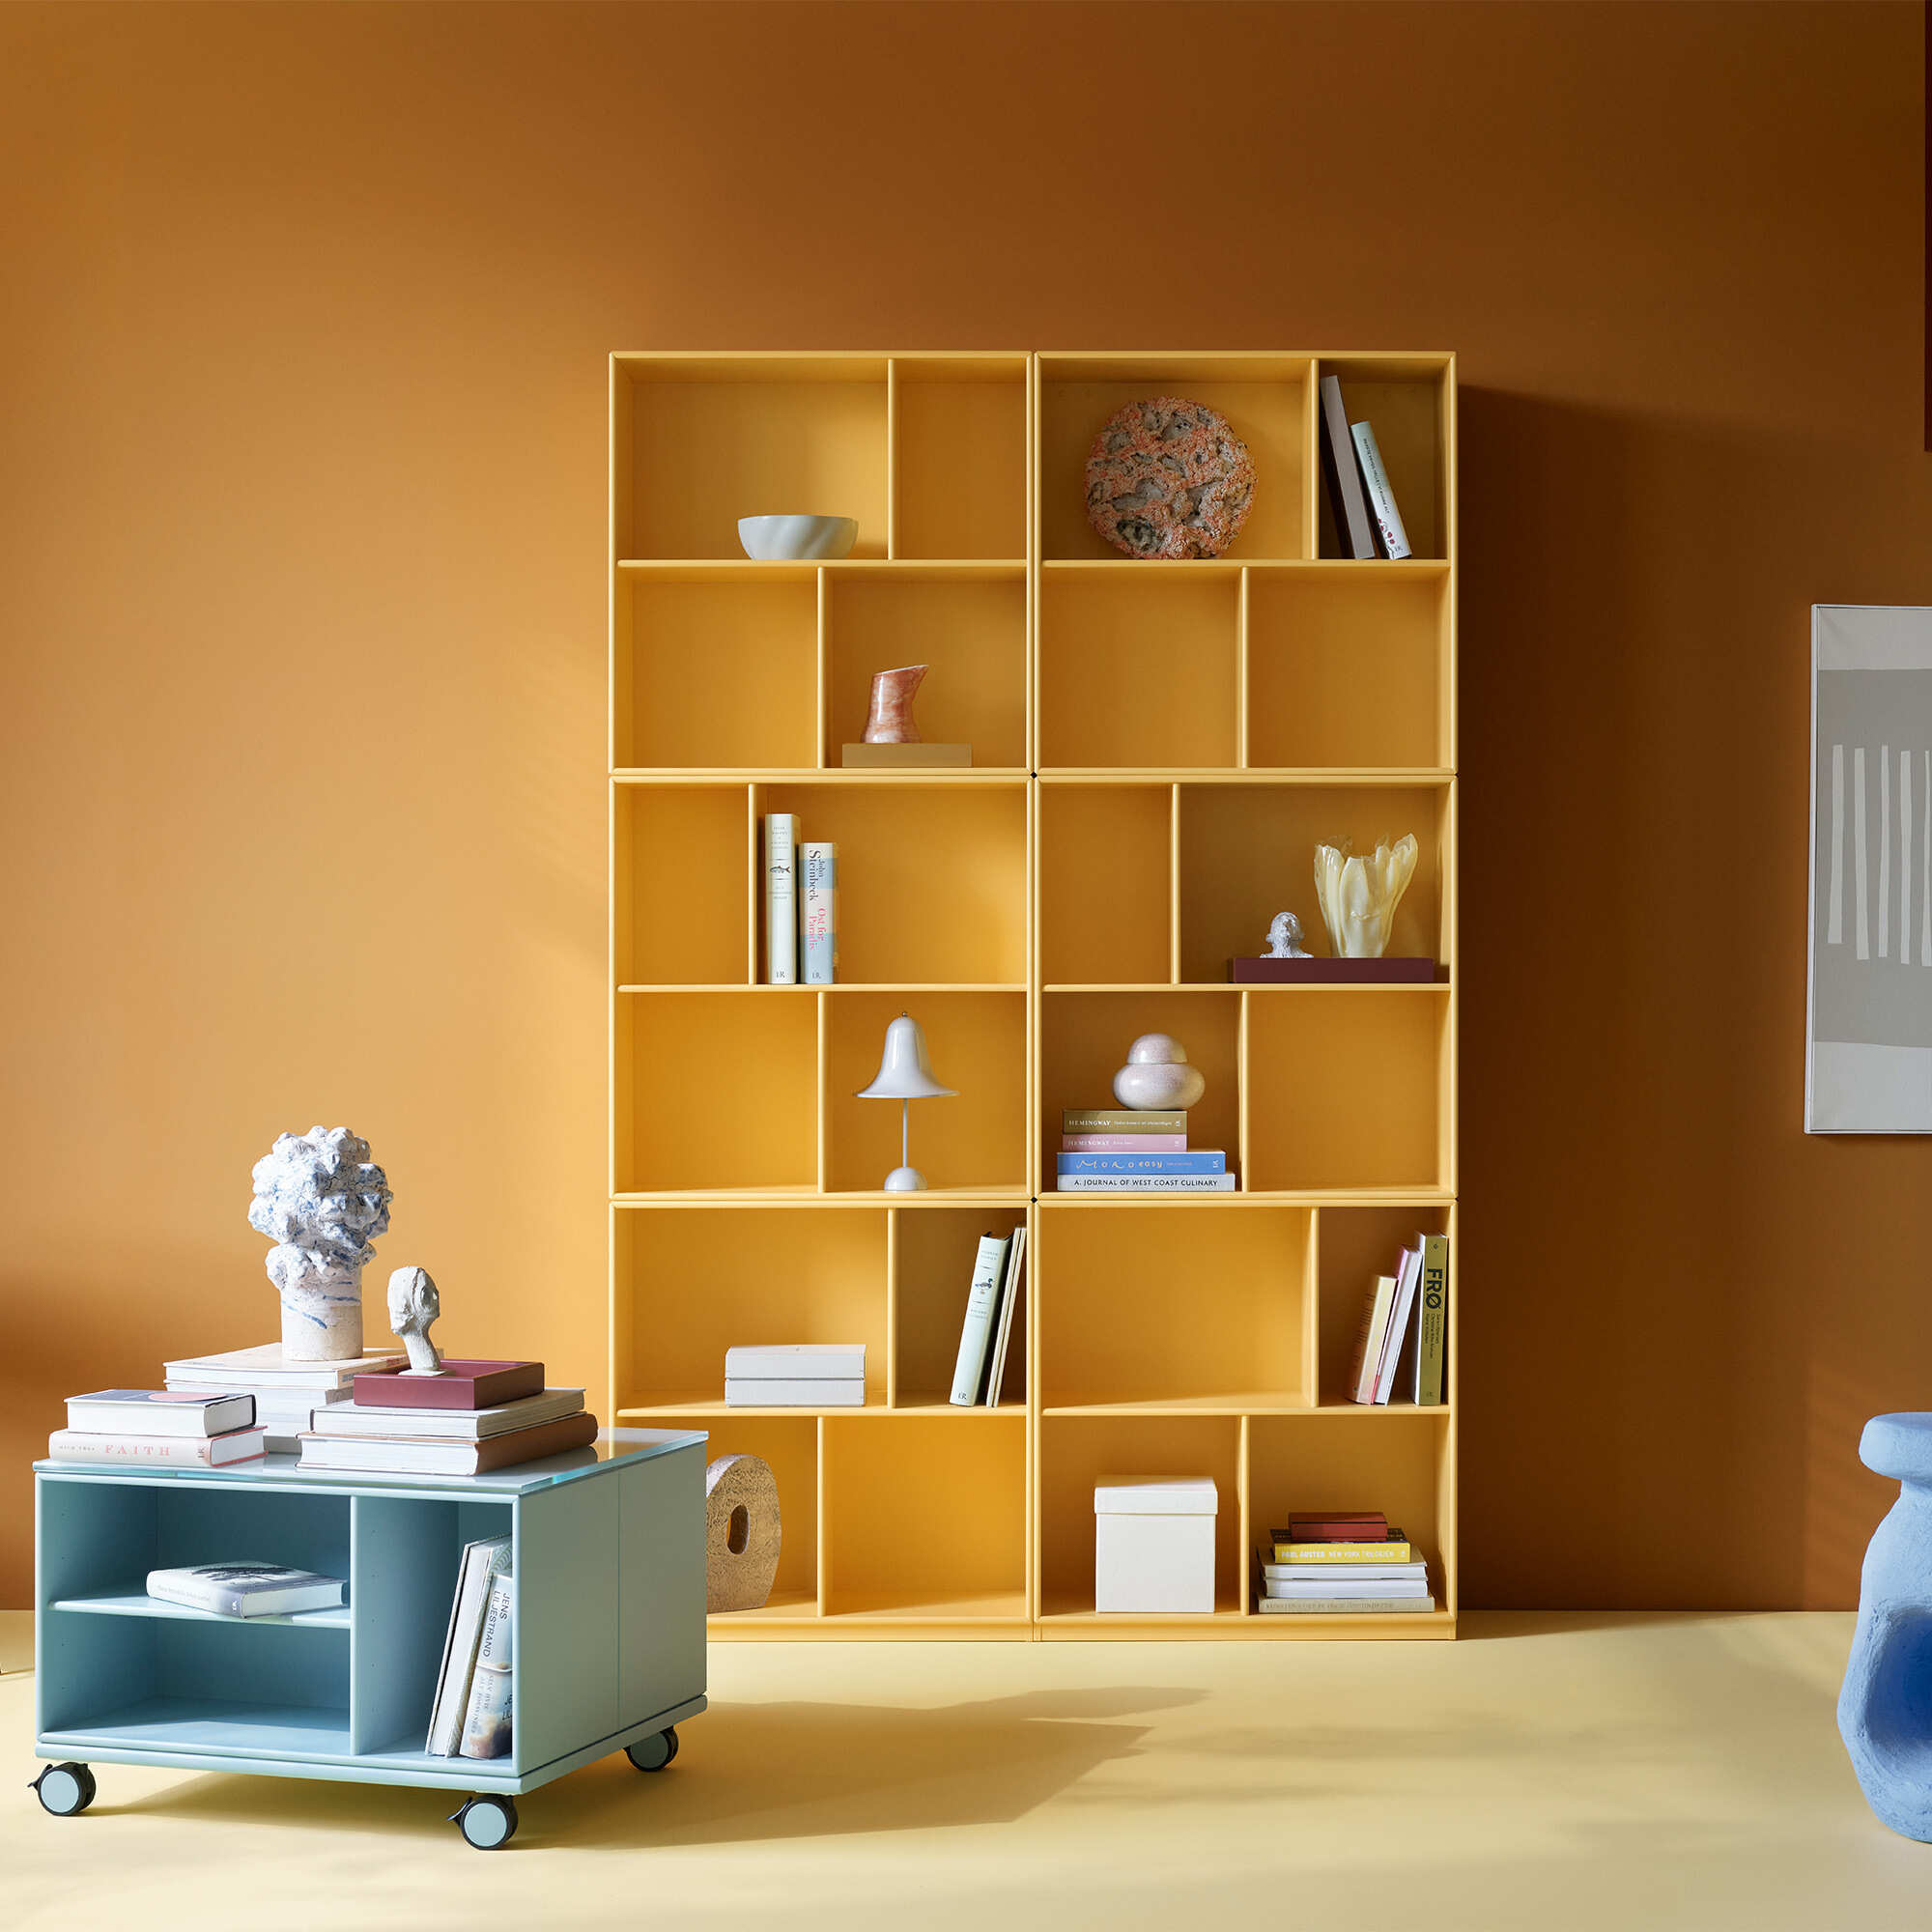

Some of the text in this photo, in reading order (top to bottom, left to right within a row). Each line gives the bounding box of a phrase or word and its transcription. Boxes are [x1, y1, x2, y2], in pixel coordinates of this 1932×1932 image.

[810, 849, 821, 901] Steinbeck
[104, 1444, 170, 1457] FAITH
[483, 1590, 501, 1658] LILJESTRAND
[498, 1592, 510, 1620] JENS
